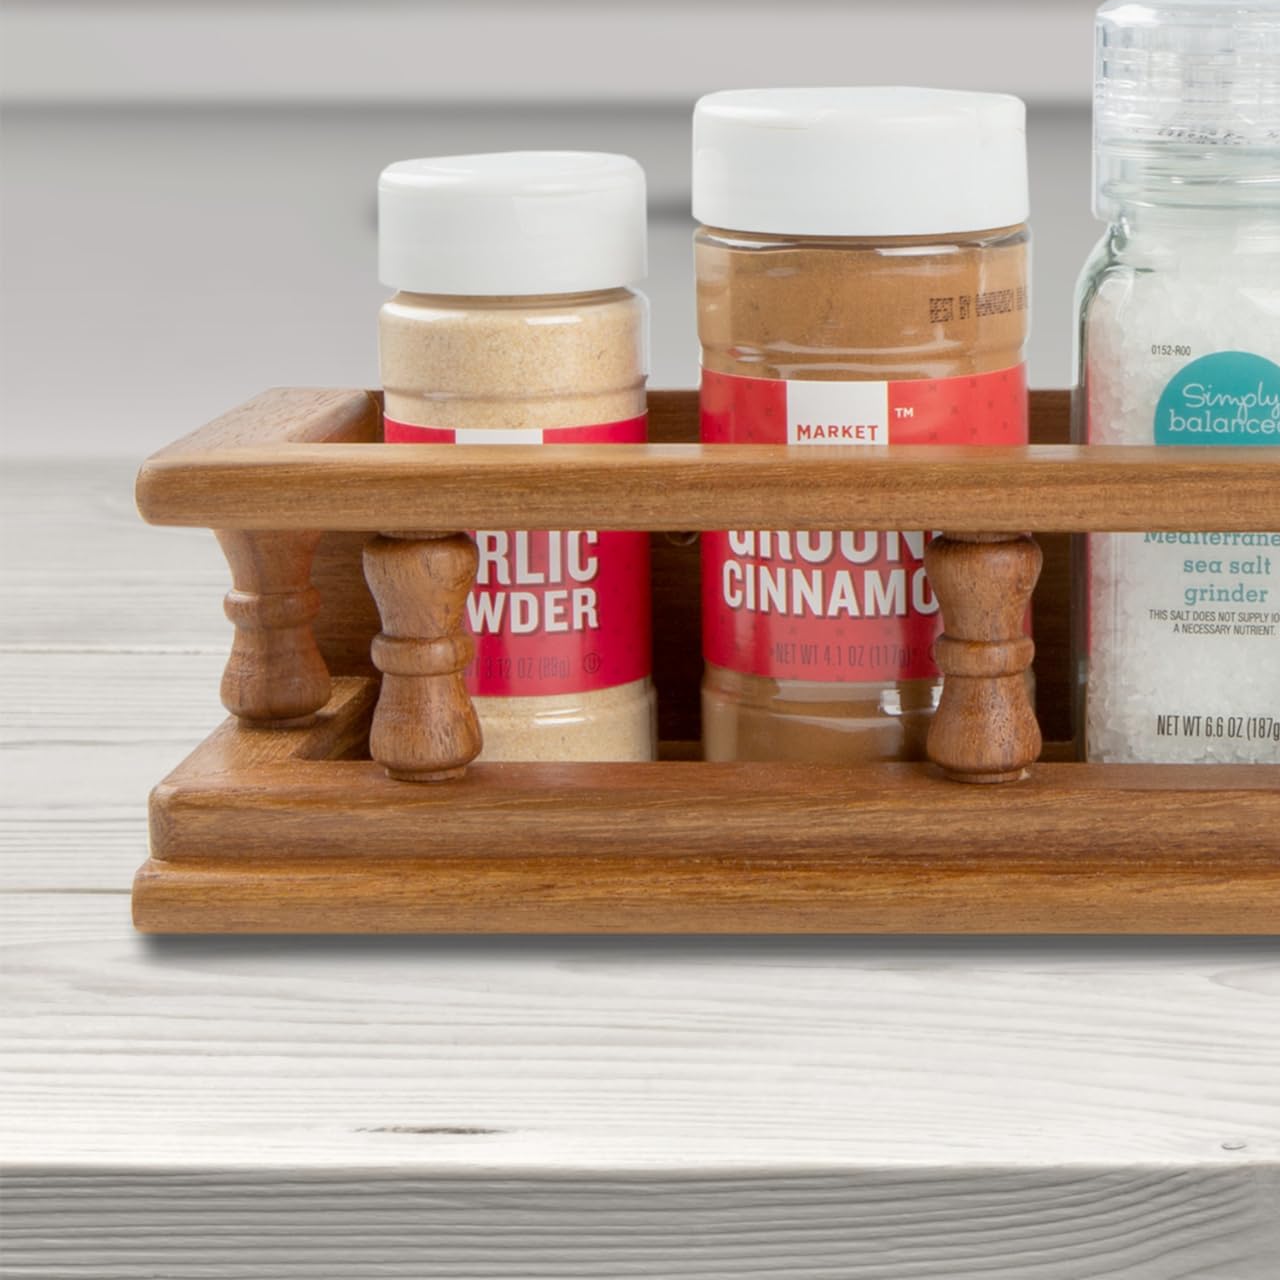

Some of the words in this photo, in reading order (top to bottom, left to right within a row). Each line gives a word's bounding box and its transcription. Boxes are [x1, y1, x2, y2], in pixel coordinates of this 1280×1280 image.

[796, 424, 879, 441] MARKET
[476, 530, 598, 585] RLIC
[1183, 559, 1223, 573] sea
[1229, 555, 1271, 575] salt
[723, 559, 940, 616] CINNAMO
[1184, 583, 1268, 606] grinder
[466, 588, 599, 634] WDER
[1149, 609, 1167, 620] THIS
[1170, 610, 1190, 621] SALT
[1193, 611, 1216, 622] DOES
[1218, 612, 1235, 622] NOT
[1238, 612, 1268, 623] SUPPLY
[1181, 624, 1231, 635] NECESSARY
[775, 642, 797, 665] NET
[800, 643, 819, 666] WT
[847, 644, 864, 667] OZ
[1156, 715, 1179, 736] NET
[1182, 716, 1202, 737] WT
[1205, 717, 1224, 738] 6.6
[1227, 717, 1244, 738] OZ
